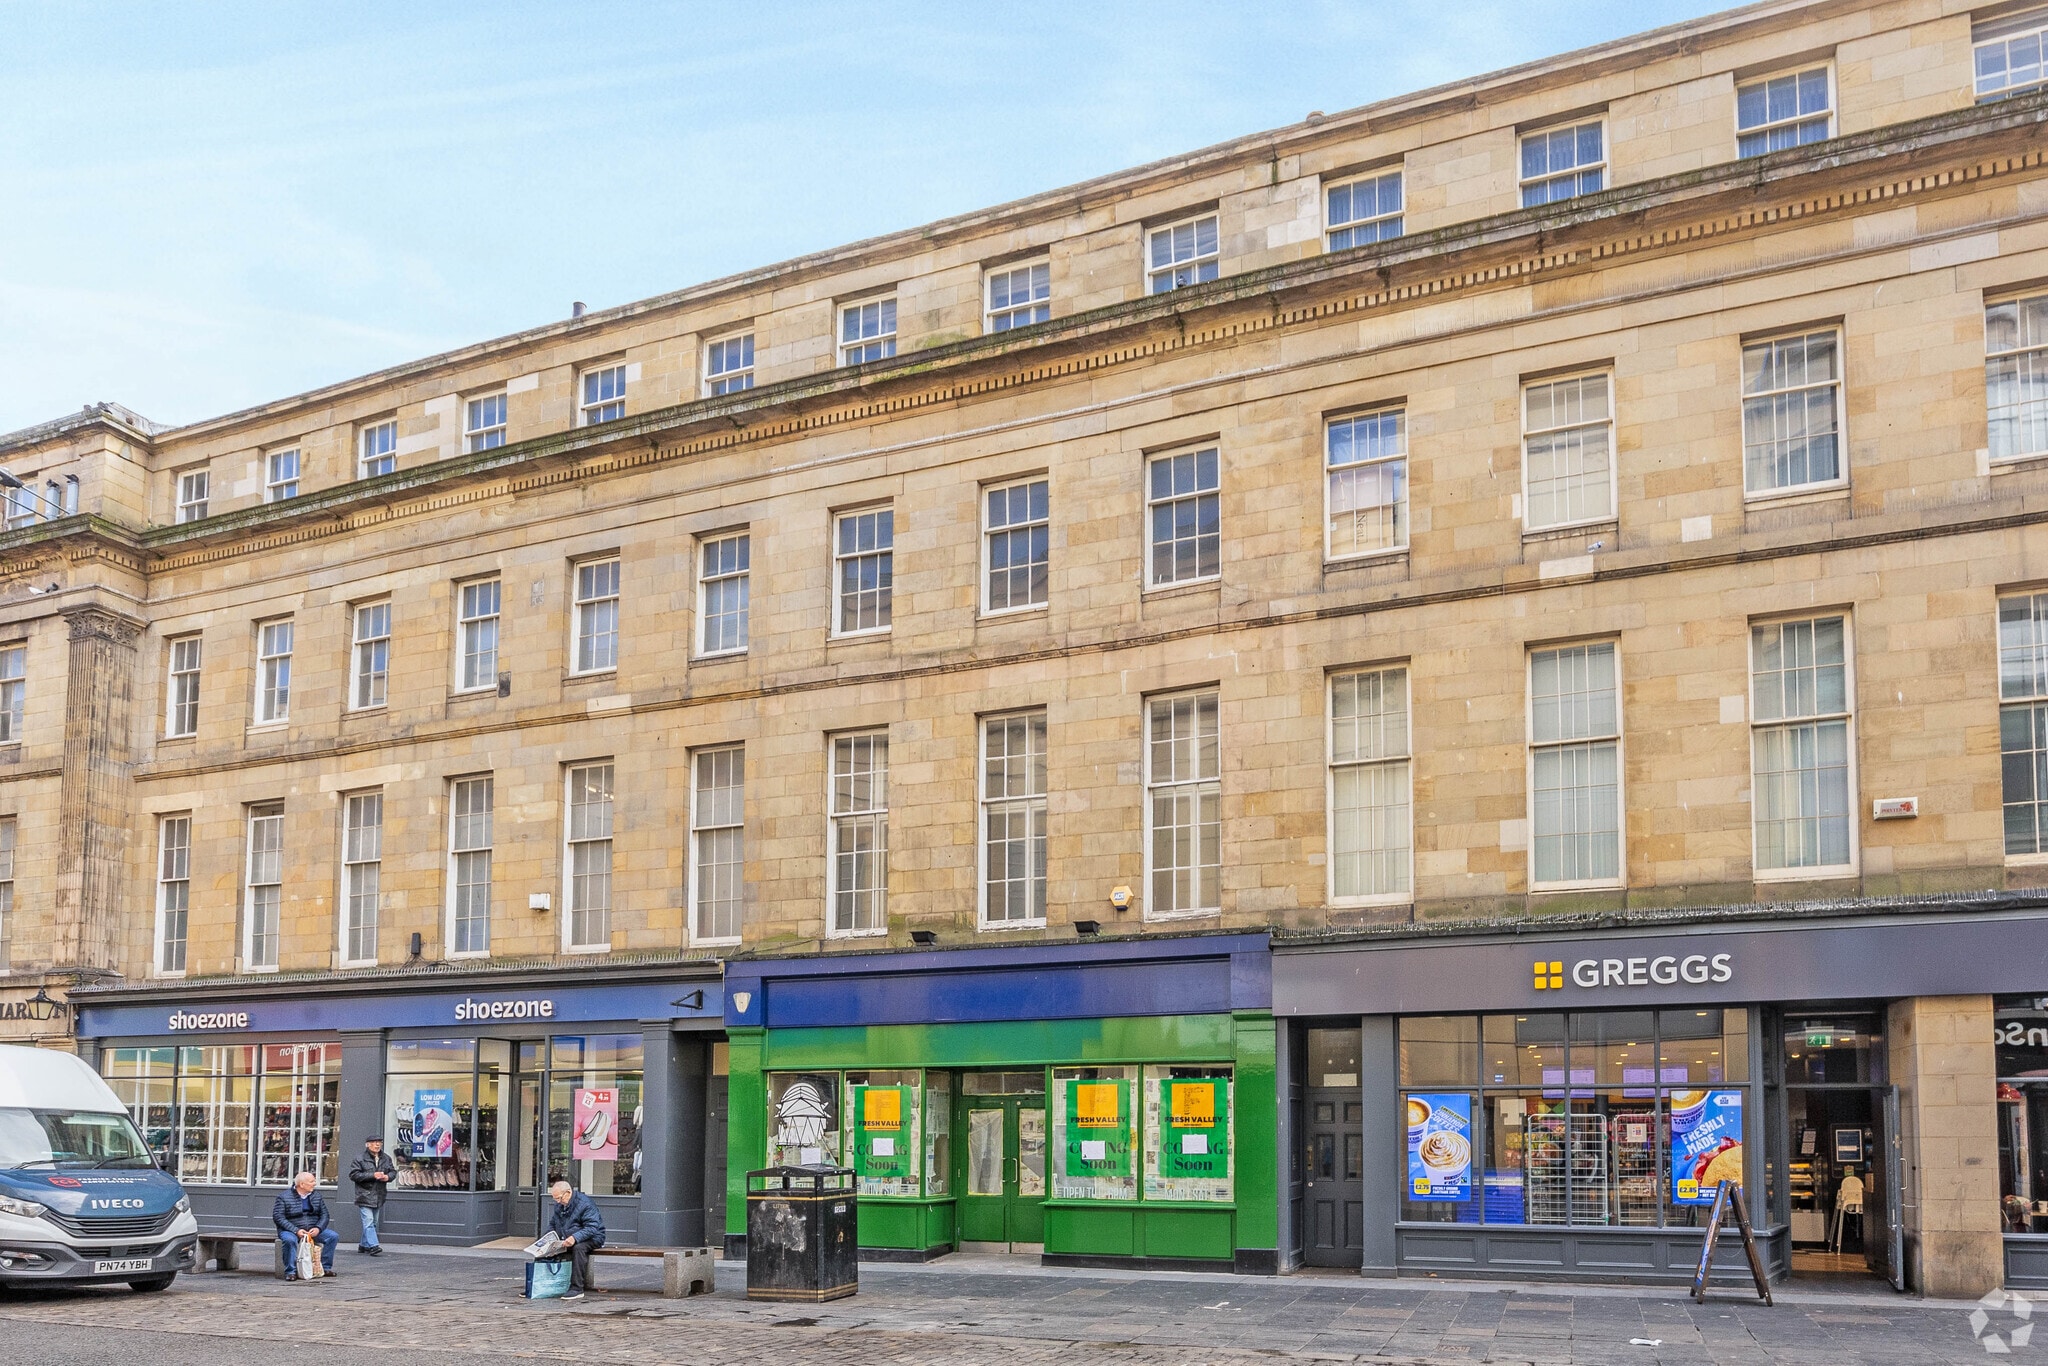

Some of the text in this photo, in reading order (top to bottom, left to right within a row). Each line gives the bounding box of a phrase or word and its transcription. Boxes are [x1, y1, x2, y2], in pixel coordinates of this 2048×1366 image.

[1572, 953, 1733, 988] GREGGS
[455, 998, 553, 1020] shoezone
[168, 1010, 248, 1030] shoezone
[1681, 1114, 1726, 1145] FRESHLY
[857, 1143, 908, 1156] CONG
[1069, 1141, 1127, 1154] CNG
[1162, 1141, 1224, 1155] CONG
[1686, 1132, 1718, 1155] MADE
[865, 1158, 899, 1170] Soon
[1080, 1158, 1117, 1170] Soon
[1174, 1157, 1213, 1171] Soon
[91, 1199, 145, 1210] IVECO
[99, 1259, 148, 1271] PN74 YBH
